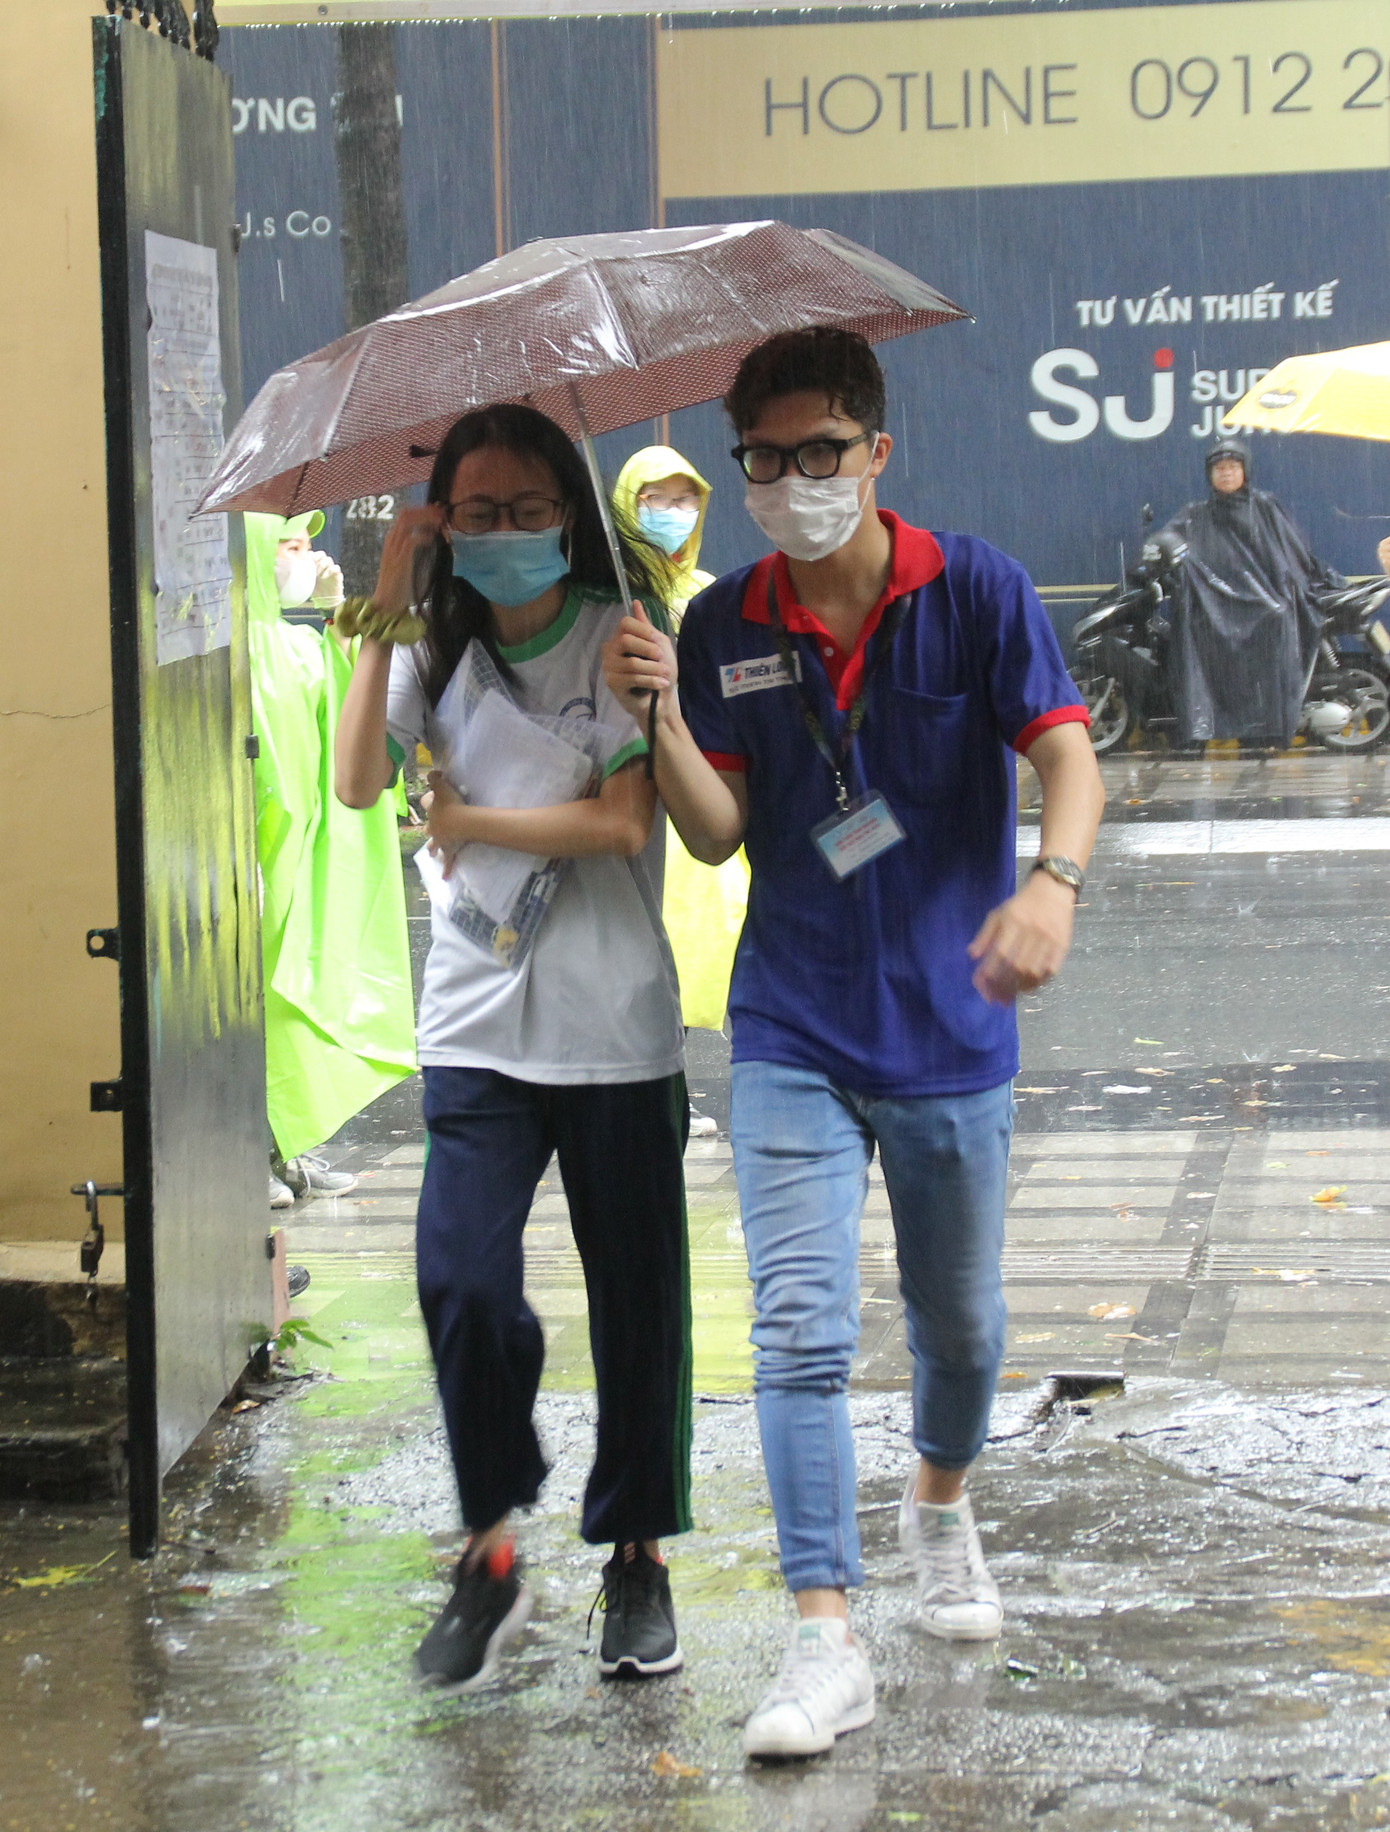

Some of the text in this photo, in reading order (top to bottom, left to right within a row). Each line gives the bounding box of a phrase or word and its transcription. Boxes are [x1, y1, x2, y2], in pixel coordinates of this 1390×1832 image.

[764, 47, 1390, 136] HOTLINE 0912 2
[1076, 278, 1340, 327] TƯ VẤN THIẾT KẾ
